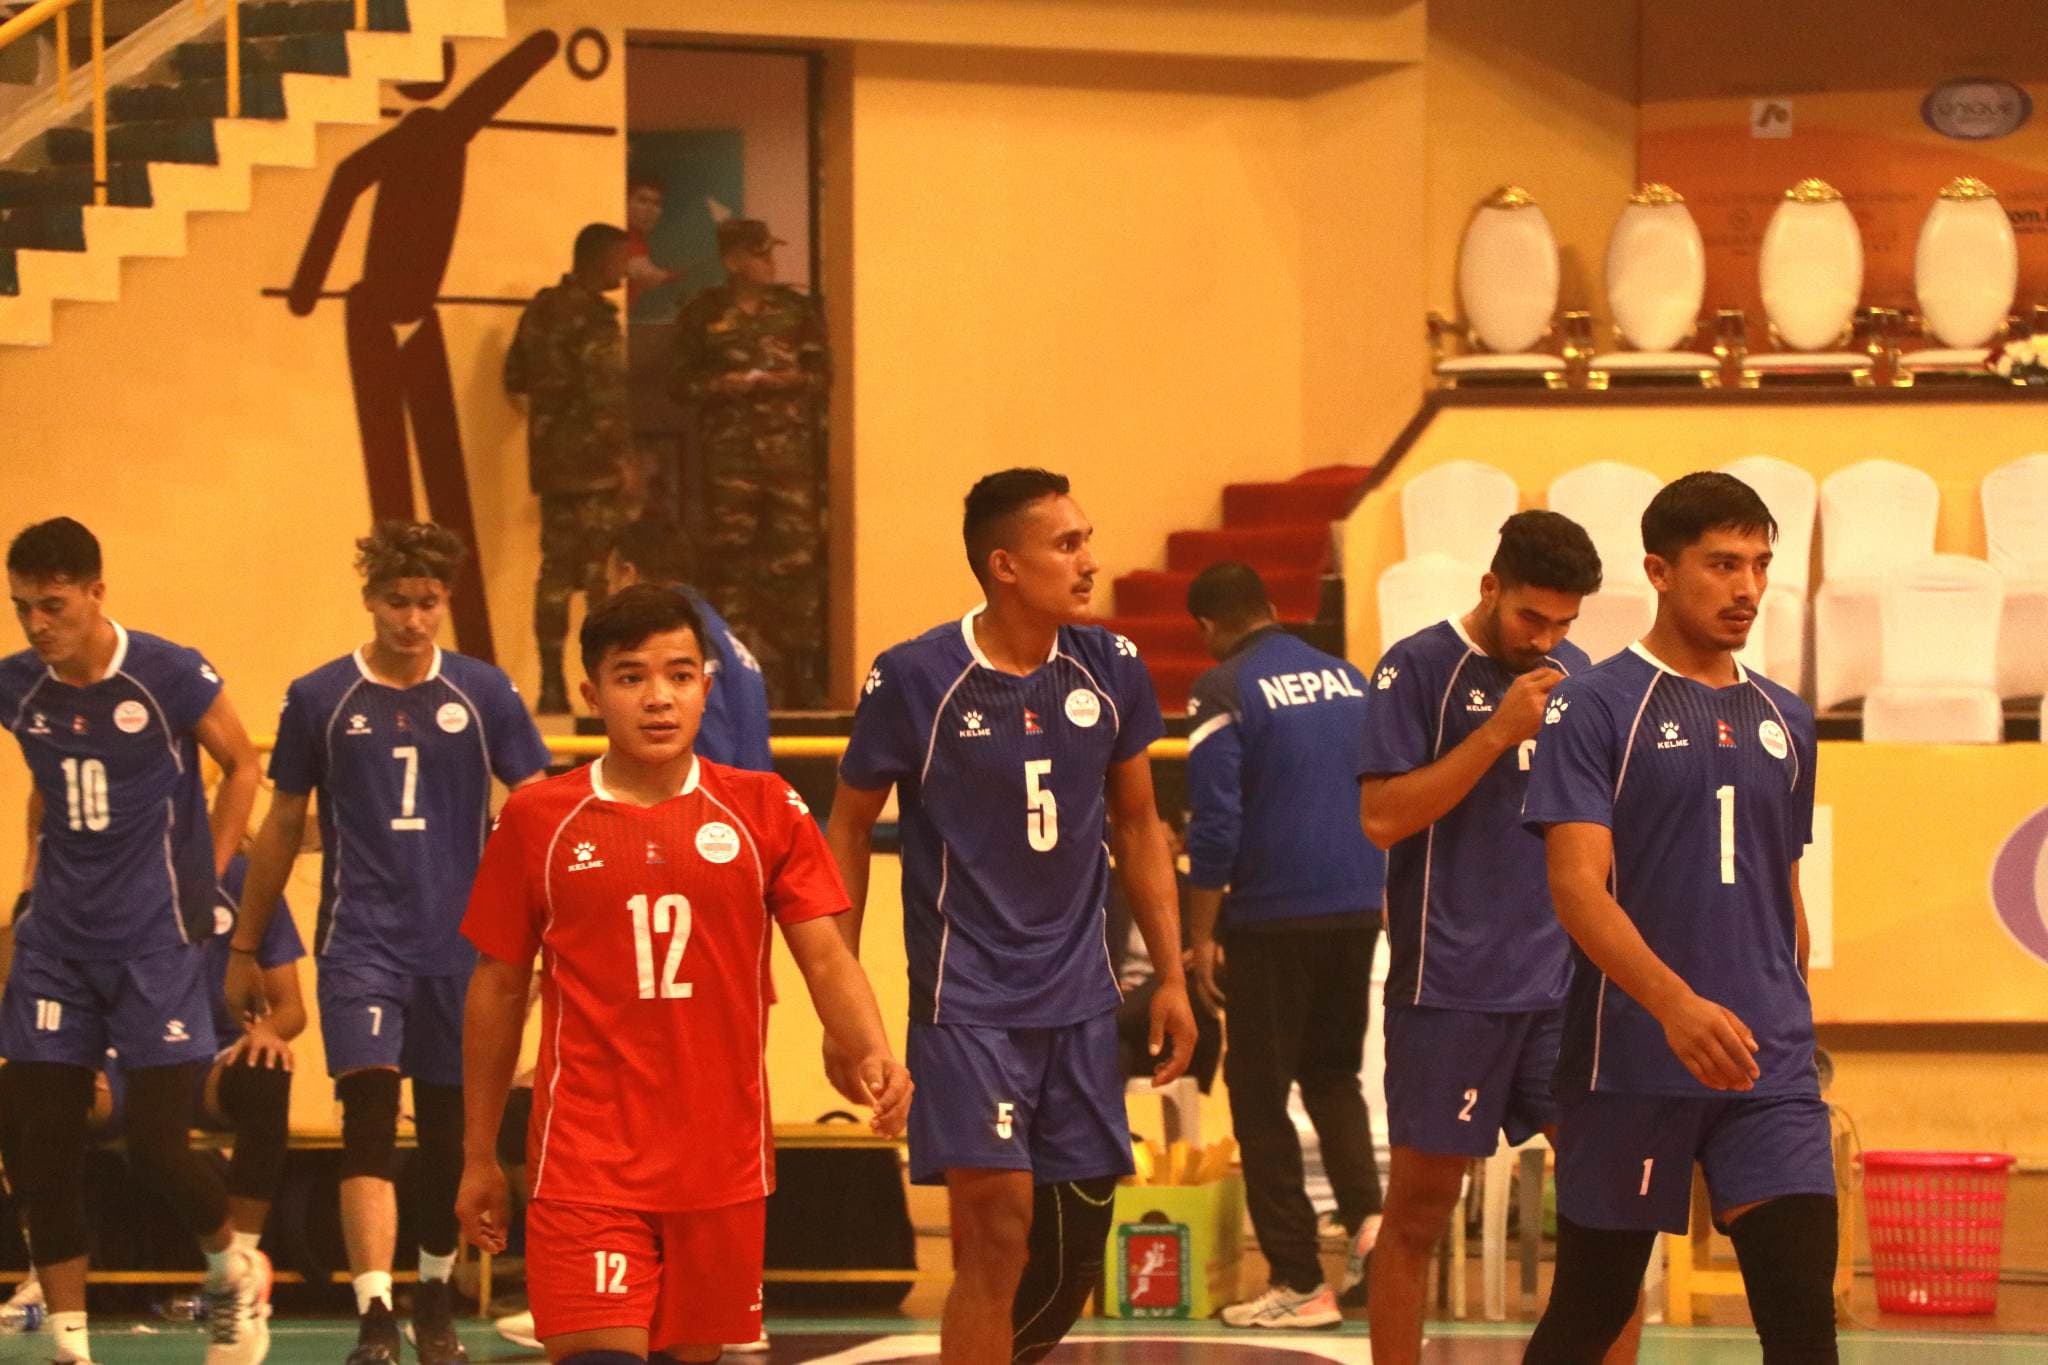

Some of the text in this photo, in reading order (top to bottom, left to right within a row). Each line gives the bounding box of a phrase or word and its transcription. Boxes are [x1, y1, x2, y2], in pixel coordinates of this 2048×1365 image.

[1258, 668, 1365, 710] NEPAL
[959, 728, 991, 738] KELME
[1657, 739, 1689, 749] KELME
[61, 758, 110, 831] 10
[1024, 759, 1058, 852] 5
[1716, 785, 1735, 884] 1
[626, 894, 693, 999] 12
[36, 1000, 62, 1031] 10
[368, 1006, 382, 1036] 7
[996, 1102, 1014, 1139] 5
[1458, 1088, 1477, 1121] 2
[1639, 1158, 1653, 1196] 1
[594, 1251, 628, 1293] 12
